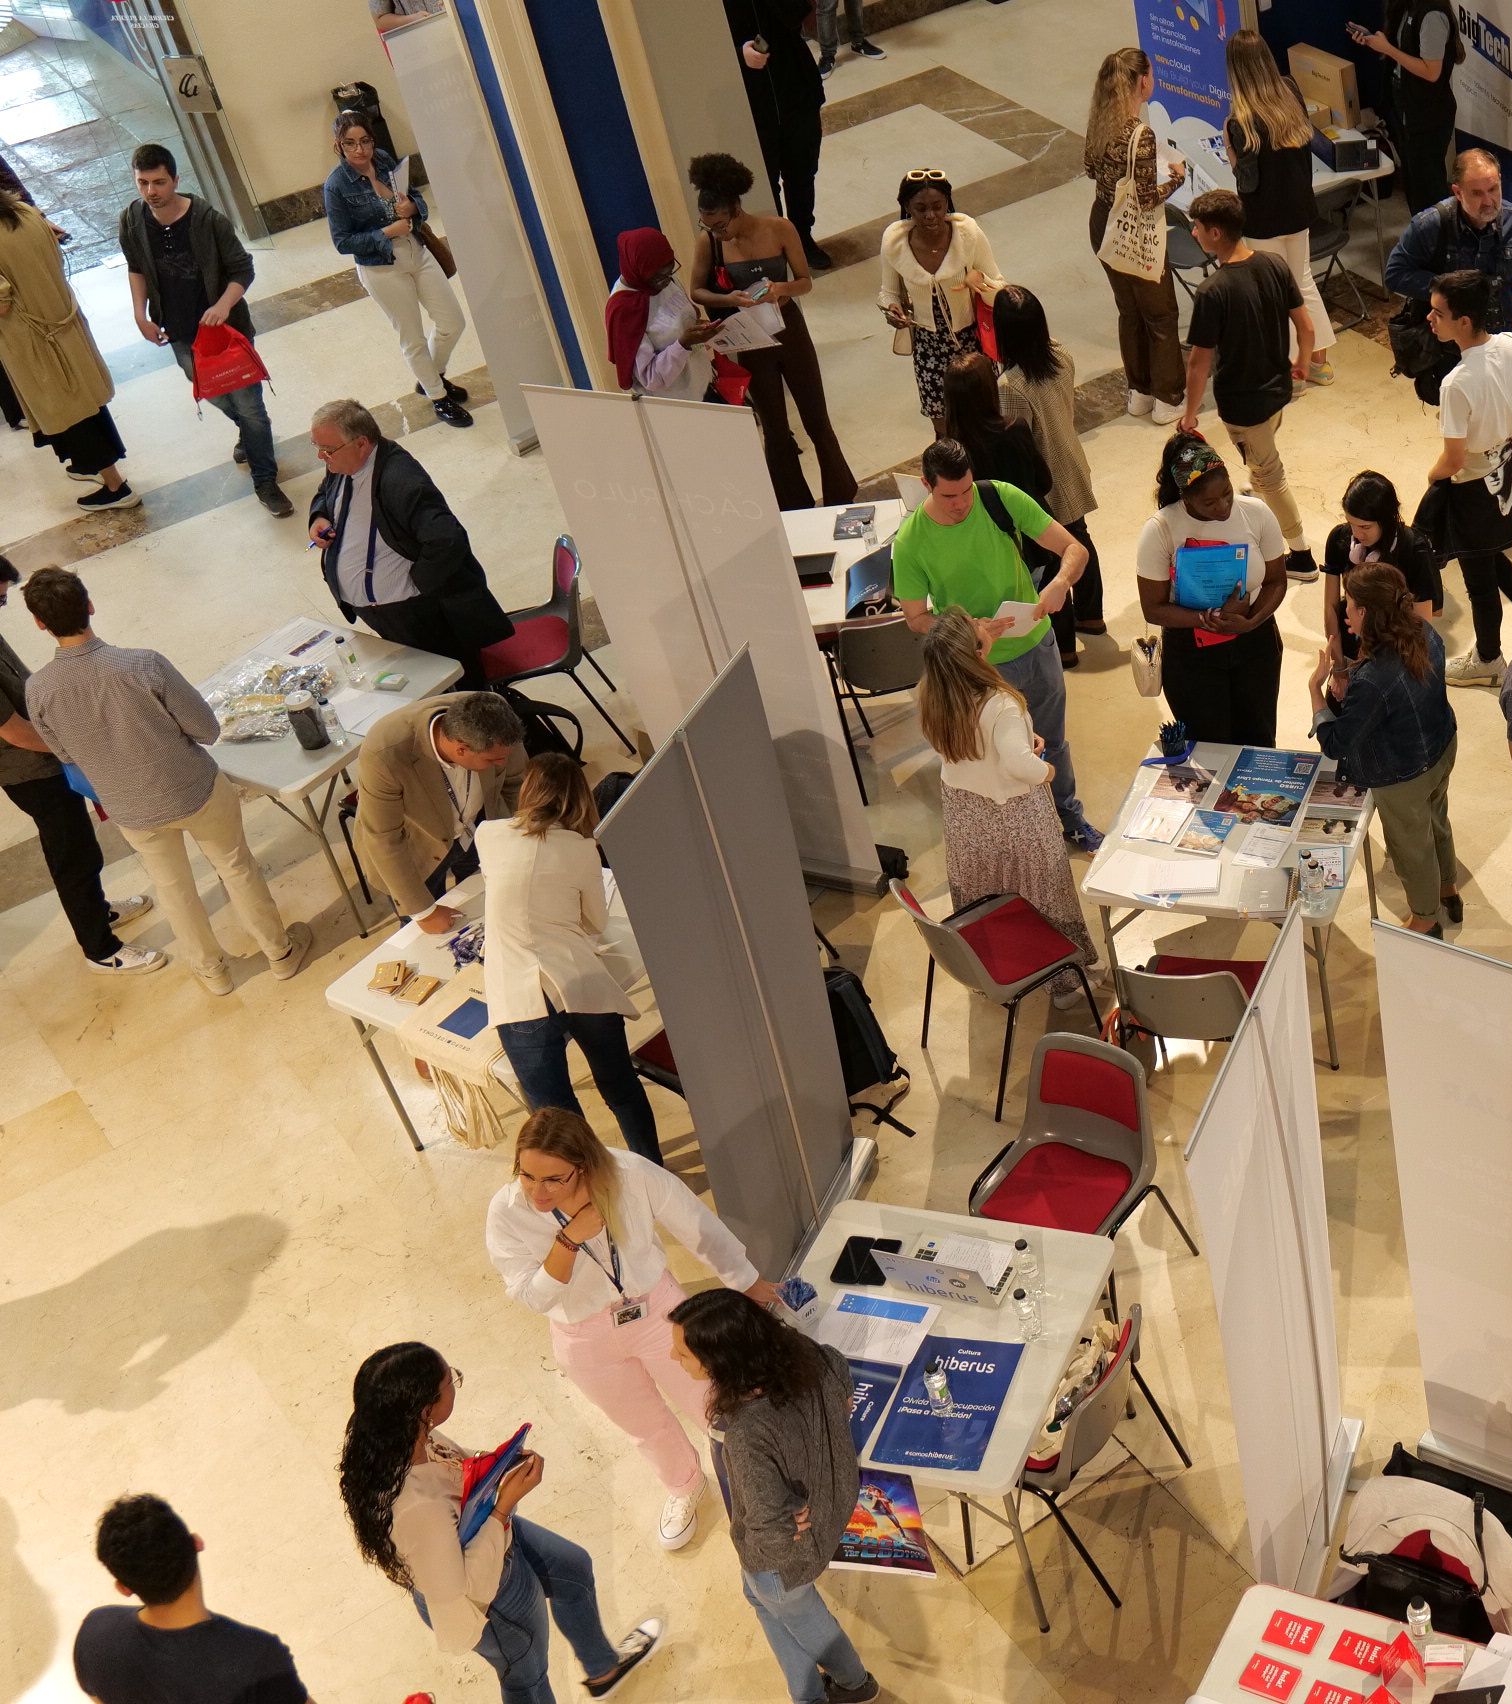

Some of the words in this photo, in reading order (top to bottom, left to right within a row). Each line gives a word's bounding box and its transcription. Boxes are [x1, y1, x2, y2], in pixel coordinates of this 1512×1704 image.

[1459, 5, 1511, 70] BigTech
[1158, 79, 1220, 108] Transformation
[1208, 84, 1232, 100] Digita
[1123, 211, 1137, 221] one
[1143, 234, 1159, 247] BAG
[905, 1280, 979, 1304] hiberus
[957, 1348, 981, 1356] Cultura
[935, 1355, 996, 1374] hiberus
[860, 1401, 874, 1422] Cultura
[903, 1396, 930, 1406] Olvida
[953, 1403, 996, 1412] ocupación
[1299, 1626, 1312, 1644] hola!
[1368, 1645, 1381, 1664] hola!
[1276, 1669, 1289, 1688] hola!
